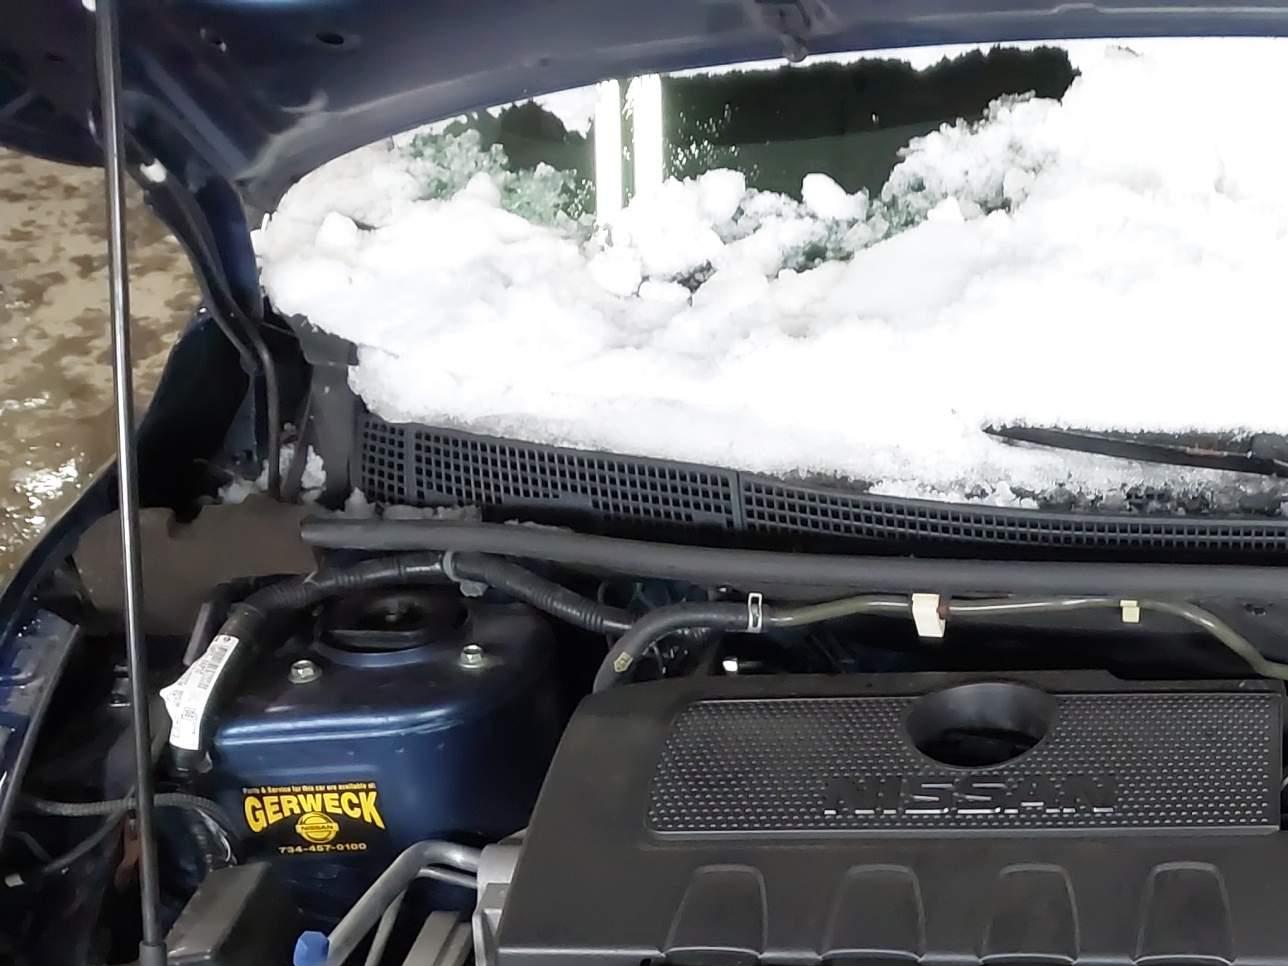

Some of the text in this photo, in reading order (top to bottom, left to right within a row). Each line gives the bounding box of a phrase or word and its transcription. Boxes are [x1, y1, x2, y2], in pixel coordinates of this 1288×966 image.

[244, 790, 385, 833] GERWECK
[823, 776, 1115, 815] NISSAN
[279, 843, 367, 854] 734-457-0100
